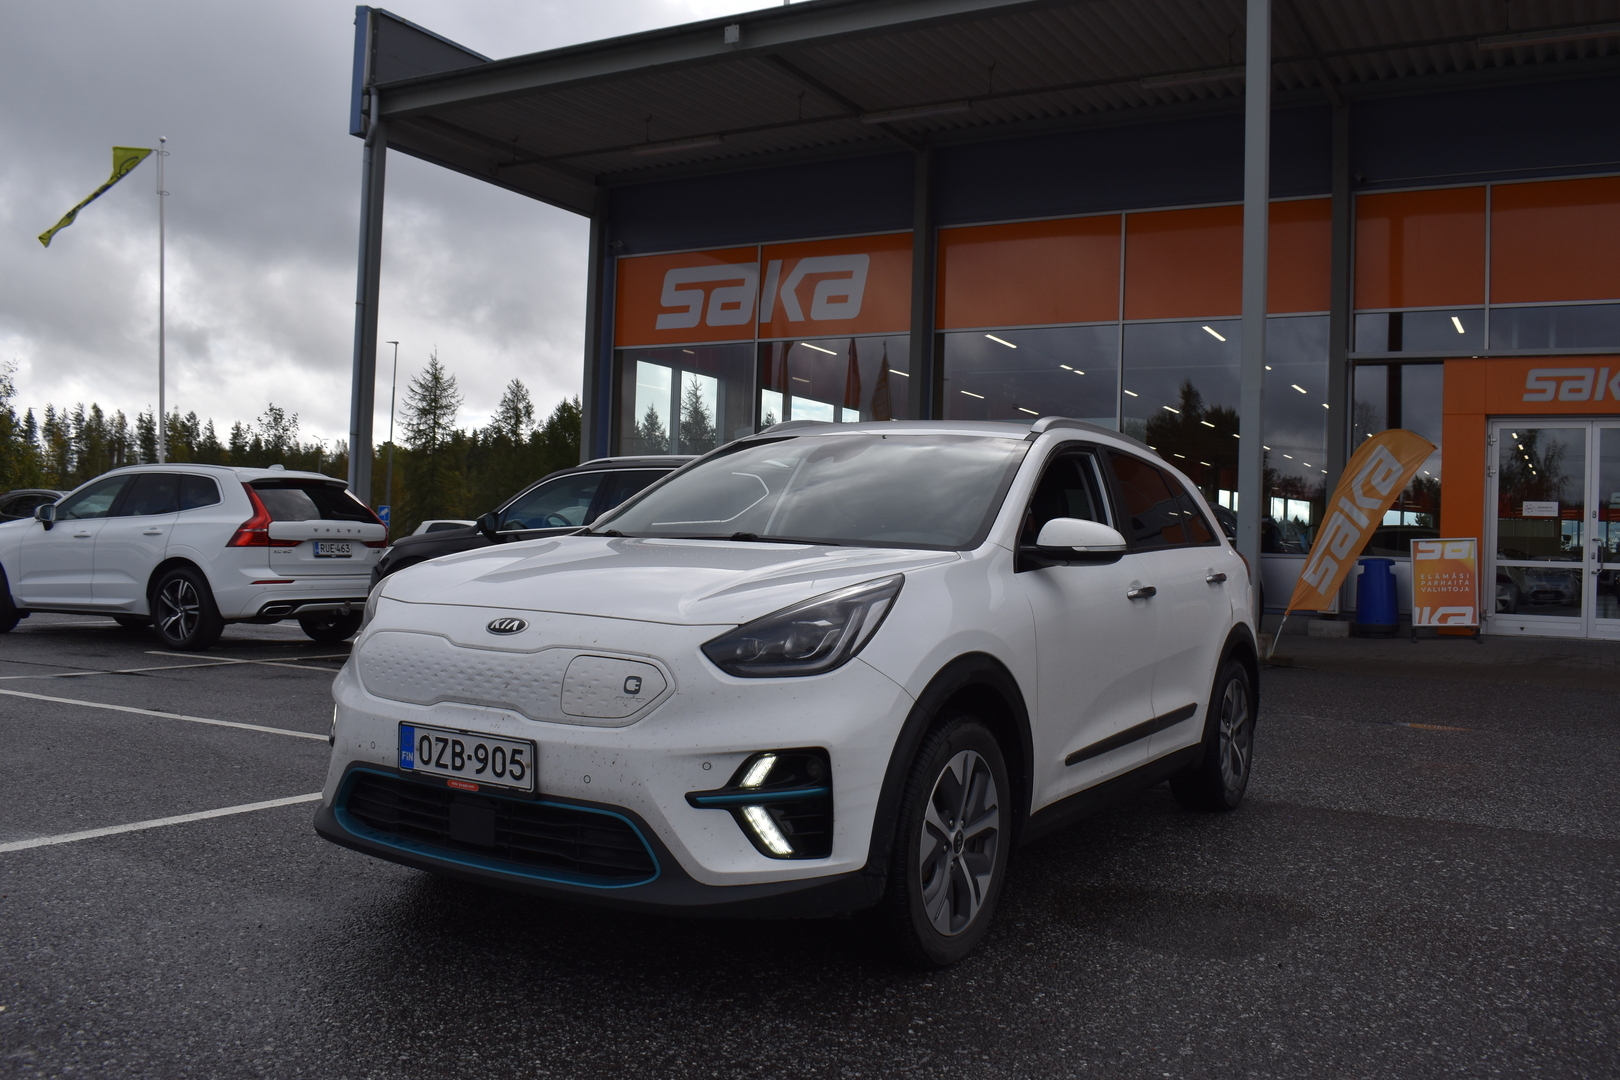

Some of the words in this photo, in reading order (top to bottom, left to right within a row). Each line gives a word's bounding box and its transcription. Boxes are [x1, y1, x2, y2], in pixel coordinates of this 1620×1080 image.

[320, 543, 350, 553] RUE-463
[490, 618, 520, 631] KIA
[402, 750, 414, 762] FIN
[419, 734, 526, 781] OZB-905
